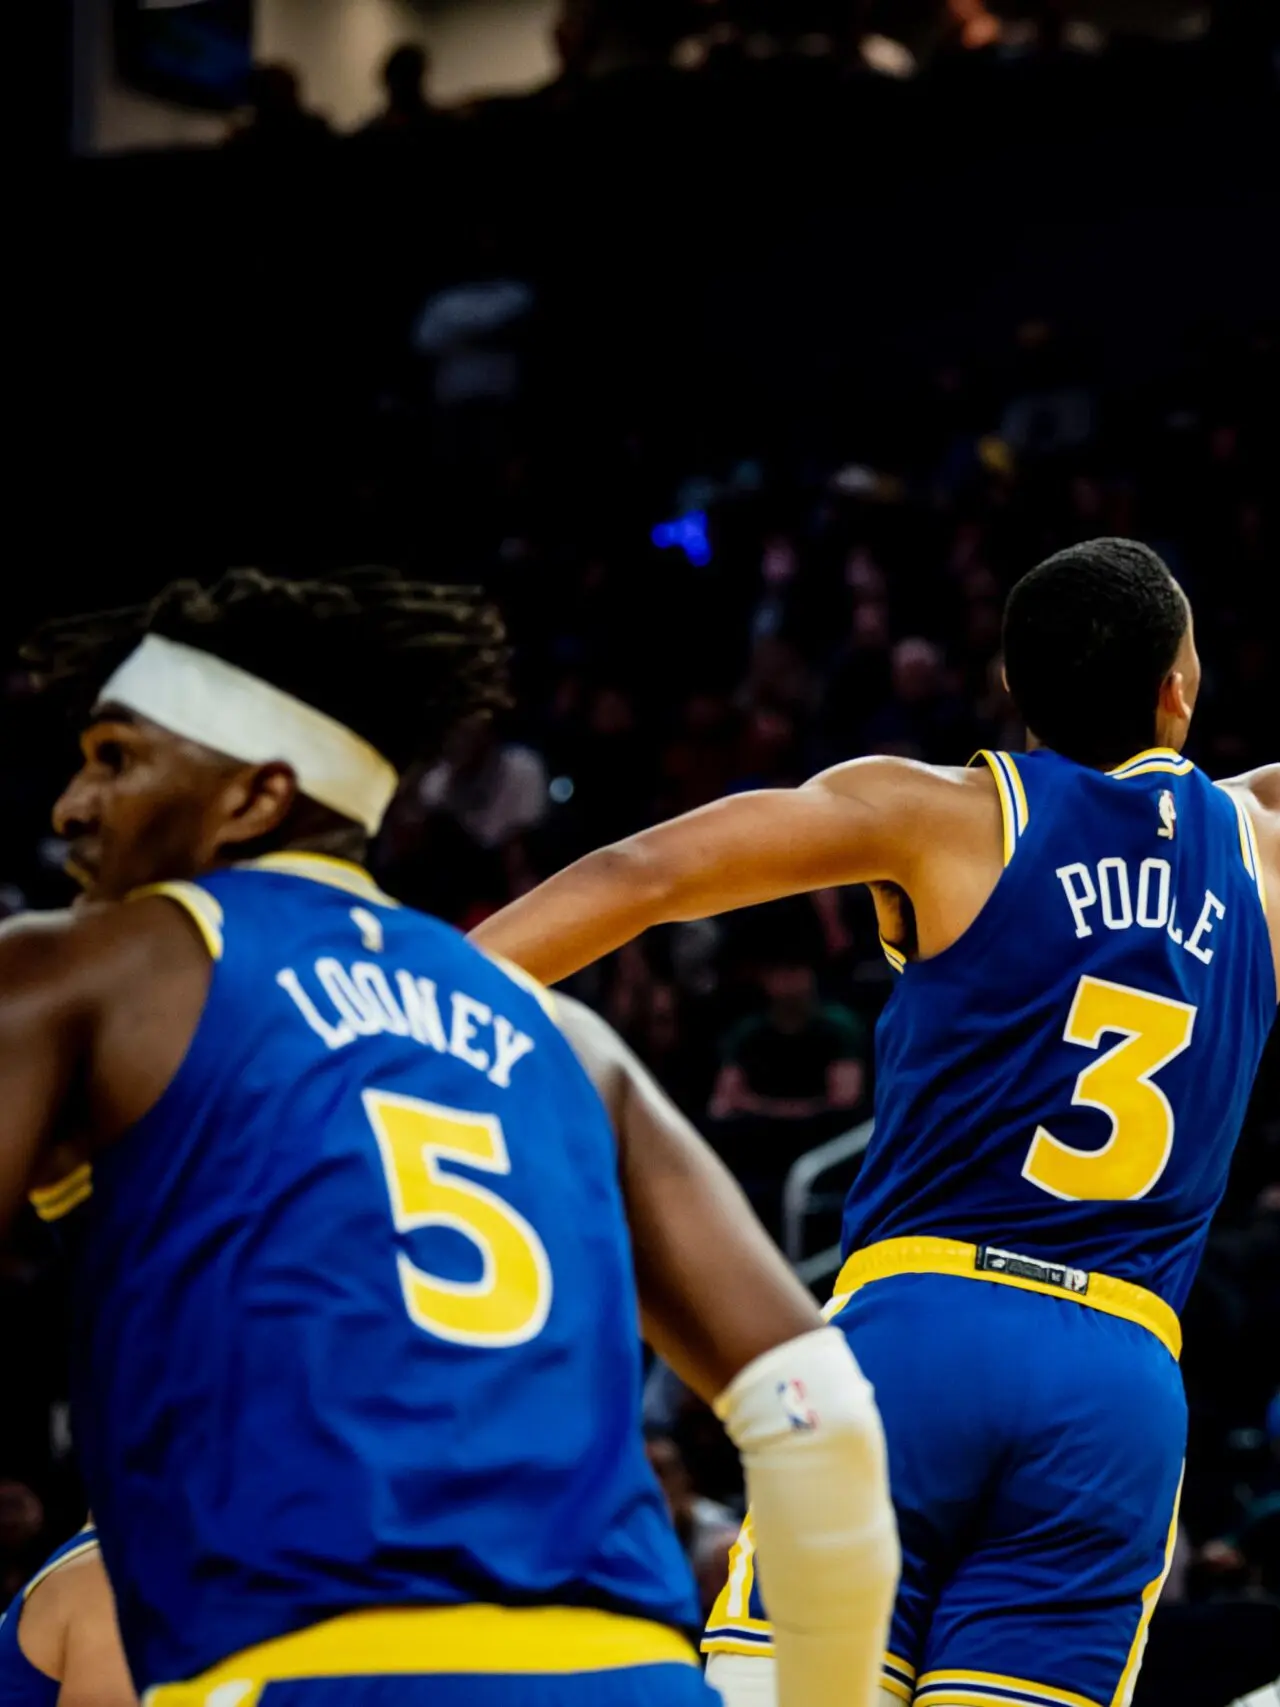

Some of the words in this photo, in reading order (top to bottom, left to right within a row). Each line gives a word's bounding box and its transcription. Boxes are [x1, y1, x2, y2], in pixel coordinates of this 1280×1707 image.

[276, 957, 534, 1088] LOONEY
[1021, 974, 1198, 1201] 3
[361, 1088, 553, 1348] 5
